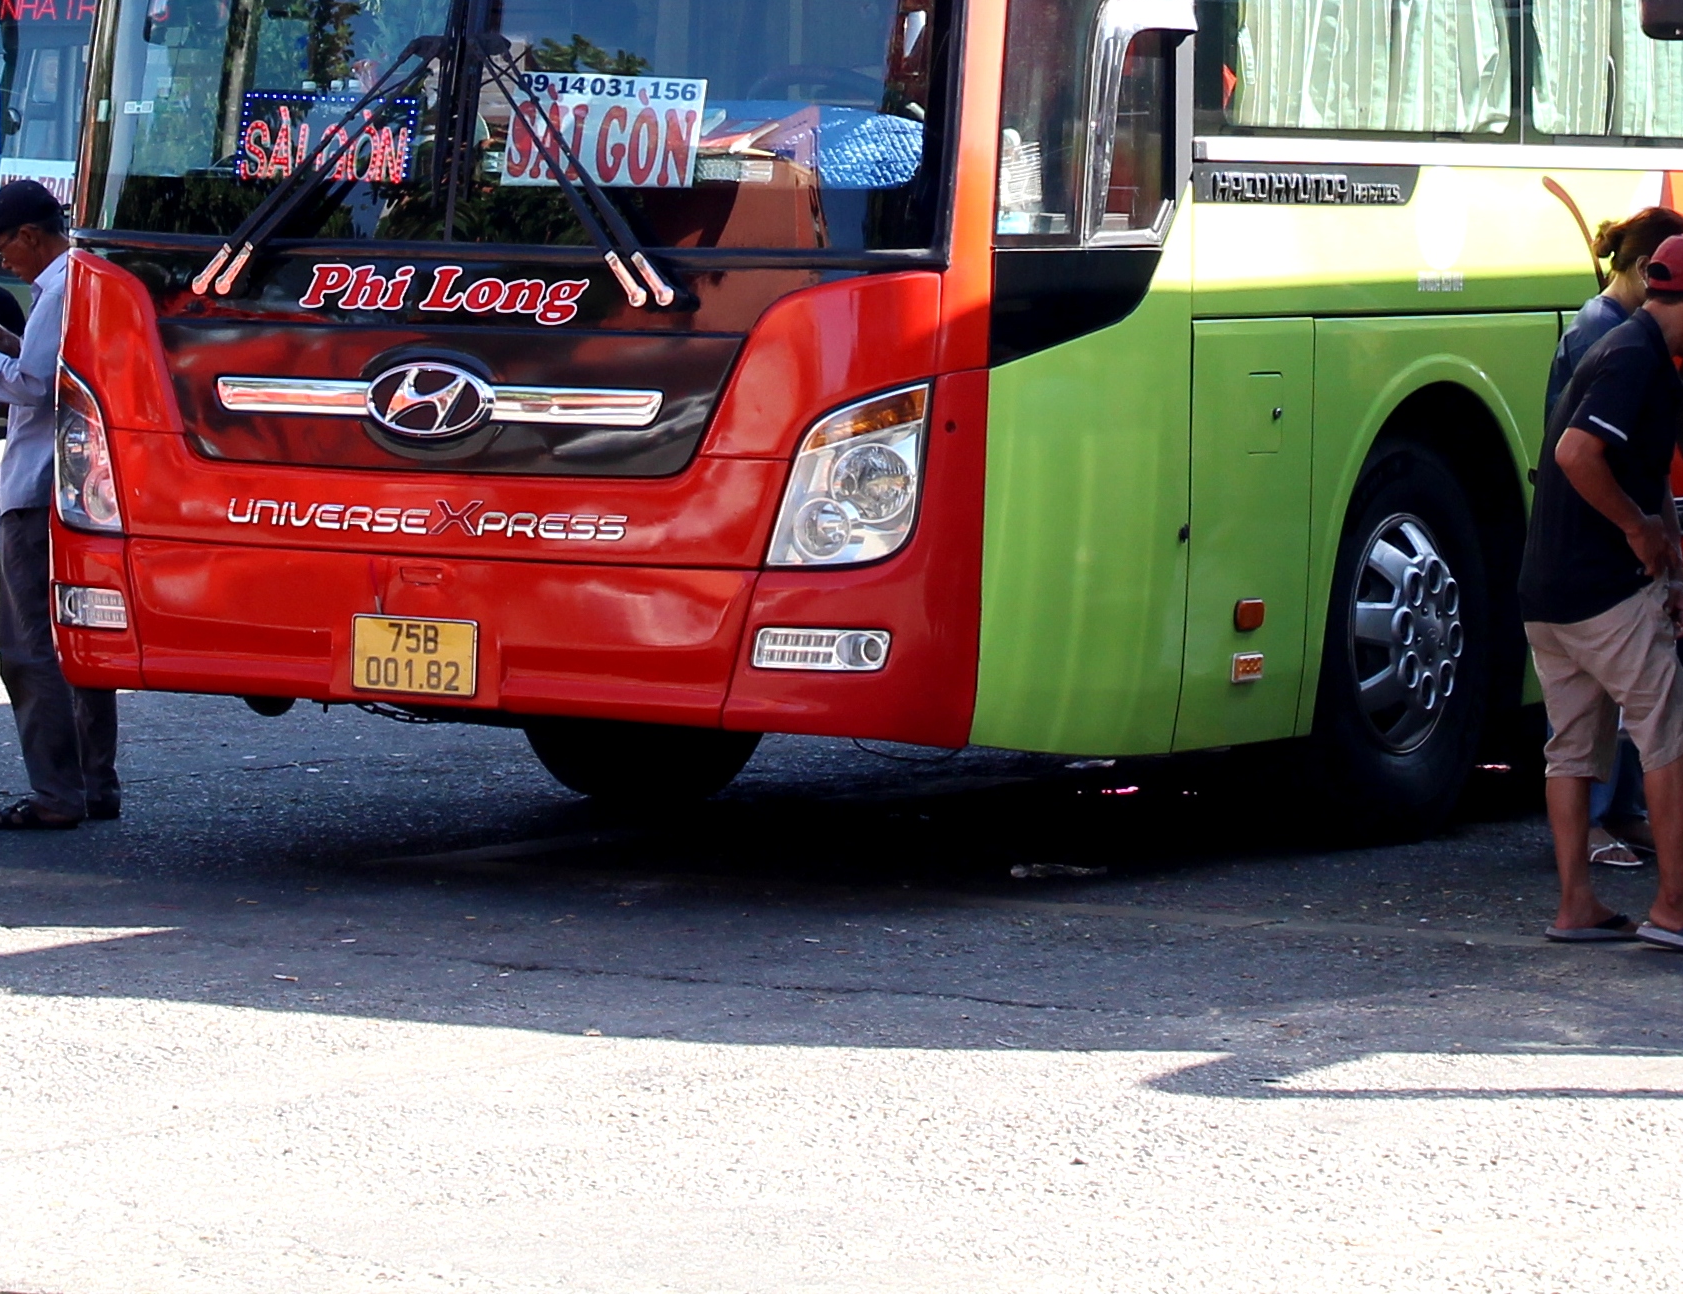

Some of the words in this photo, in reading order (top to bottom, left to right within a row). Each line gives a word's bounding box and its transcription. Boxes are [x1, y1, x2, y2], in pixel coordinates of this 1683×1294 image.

[649, 81, 697, 101] 156
[240, 105, 311, 181] SÀI
[595, 87, 698, 188] GÒN
[299, 264, 415, 310] Phi
[418, 265, 591, 326] Long
[387, 622, 440, 656] 75B
[365, 655, 461, 693] 001.82
